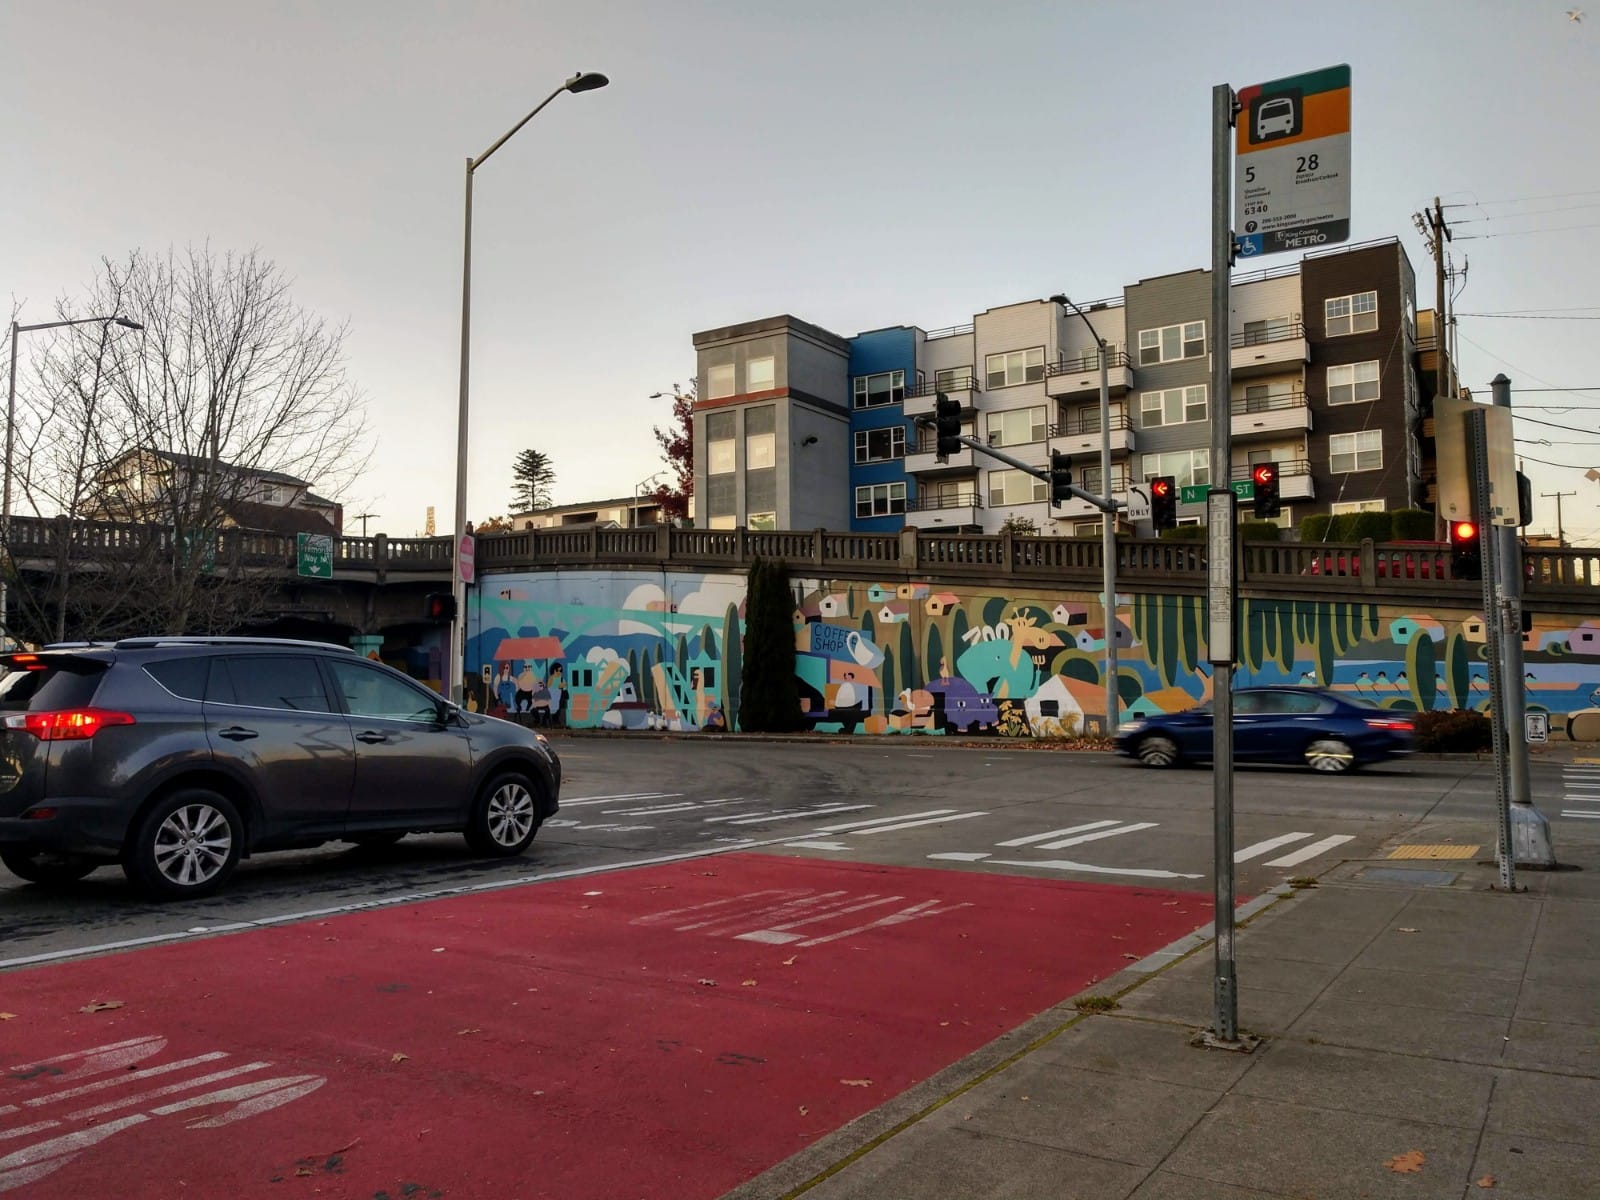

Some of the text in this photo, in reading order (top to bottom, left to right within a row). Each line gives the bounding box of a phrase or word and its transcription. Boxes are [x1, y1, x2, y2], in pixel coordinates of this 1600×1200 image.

[1296, 154, 1319, 173] 28
[1245, 166, 1255, 183] 5
[1244, 204, 1268, 216] 6340
[1285, 233, 1327, 248] METRO
[1186, 484, 1250, 499] N ST
[1130, 508, 1150, 517] ONLY
[814, 625, 857, 645] COFFEE
[814, 637, 844, 653] SHOP
